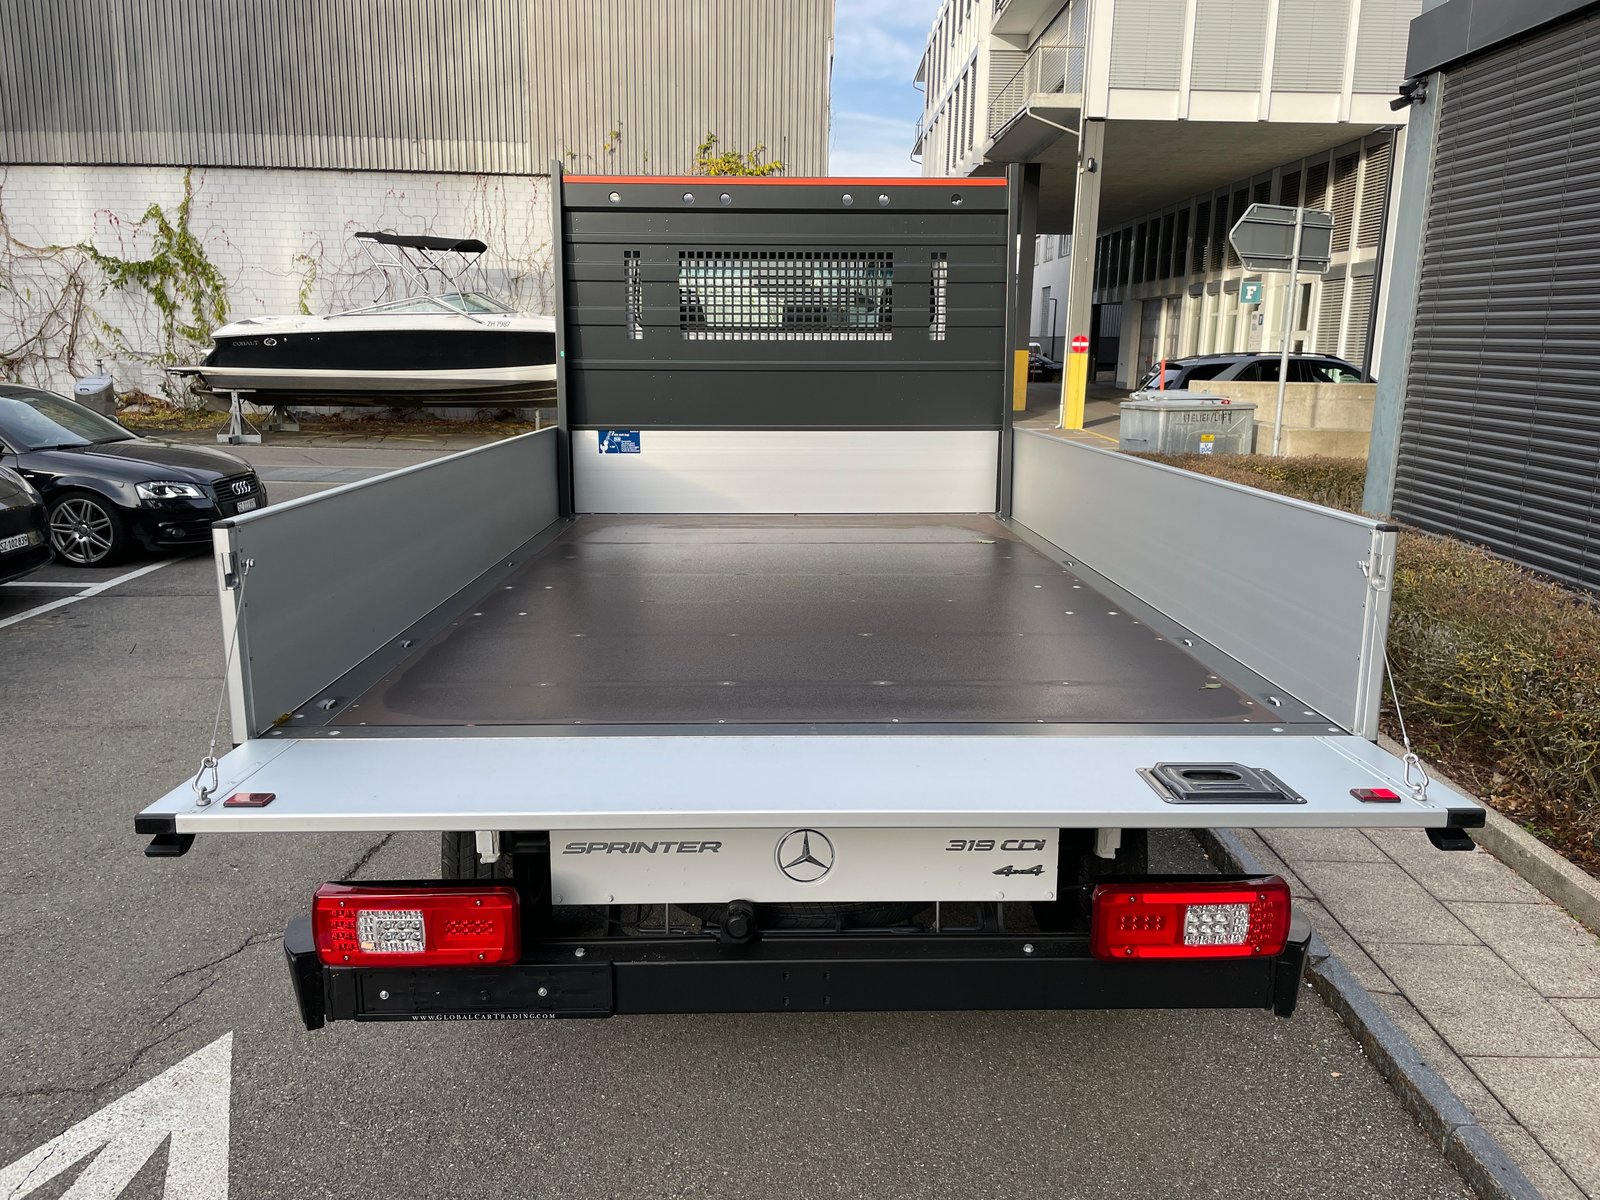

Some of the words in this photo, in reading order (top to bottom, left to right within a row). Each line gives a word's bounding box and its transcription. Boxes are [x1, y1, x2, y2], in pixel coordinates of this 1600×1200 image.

[1245, 285, 1257, 299] F
[562, 841, 723, 855] SPRINTER
[945, 839, 996, 852] 319
[1000, 839, 1047, 851] CDI
[991, 864, 1046, 877] 4x4
